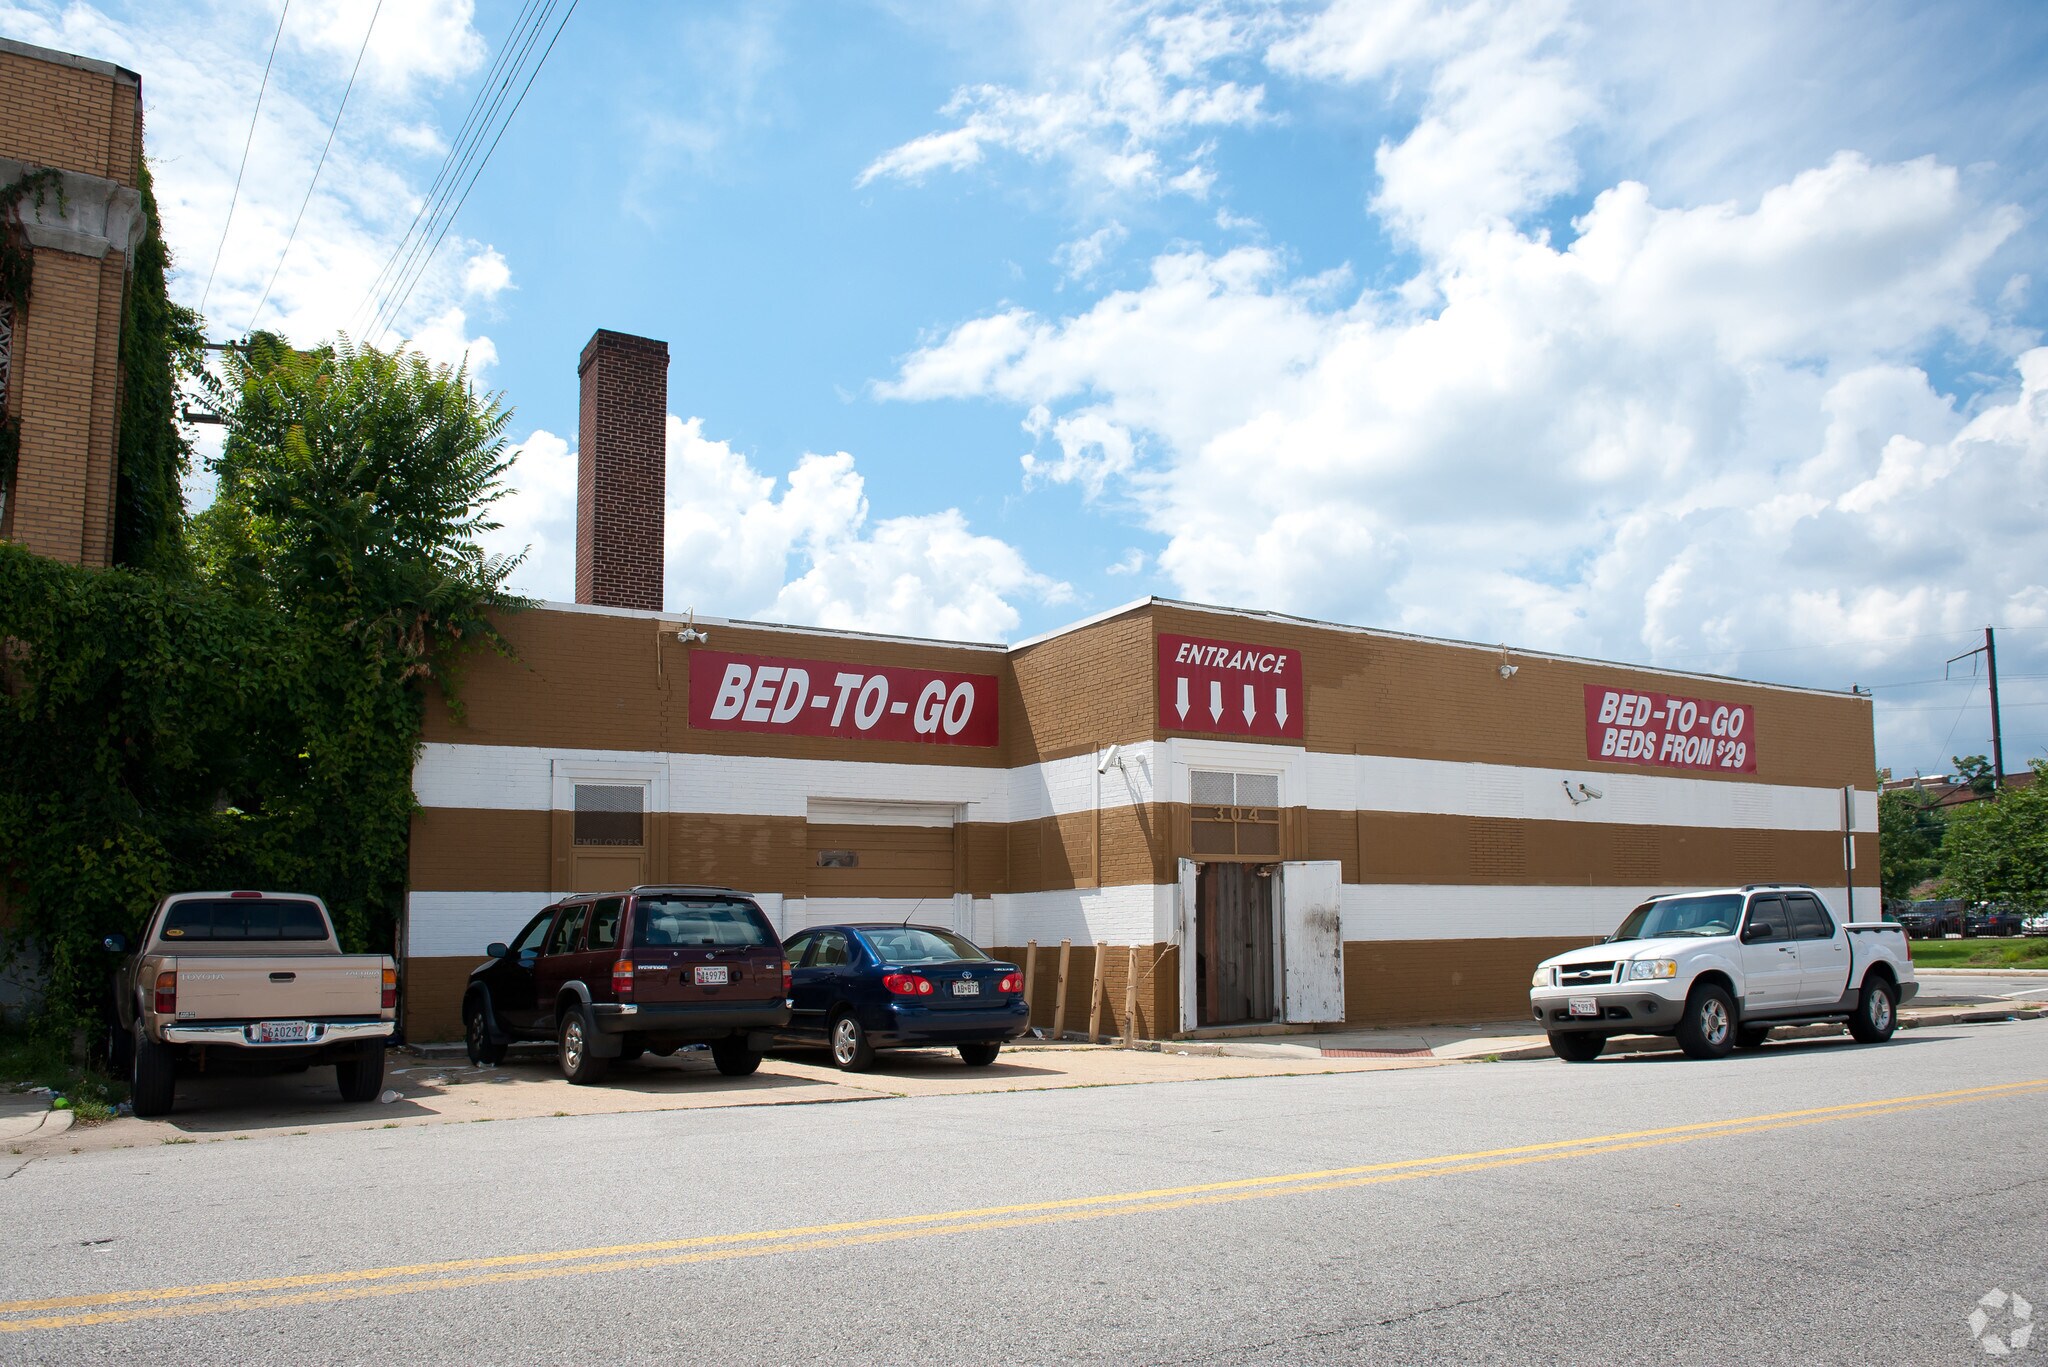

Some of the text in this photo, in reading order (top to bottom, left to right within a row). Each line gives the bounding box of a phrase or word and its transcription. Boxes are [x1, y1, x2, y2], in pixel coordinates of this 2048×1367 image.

[1175, 643, 1287, 674] ENTRANCE
[710, 663, 975, 735] BED-TO-GO
[1598, 692, 1745, 738] BED-TO-GO
[1601, 728, 1746, 768] BEDS FROM $29
[1213, 806, 1259, 822] 304
[181, 973, 225, 981] TOYOTA
